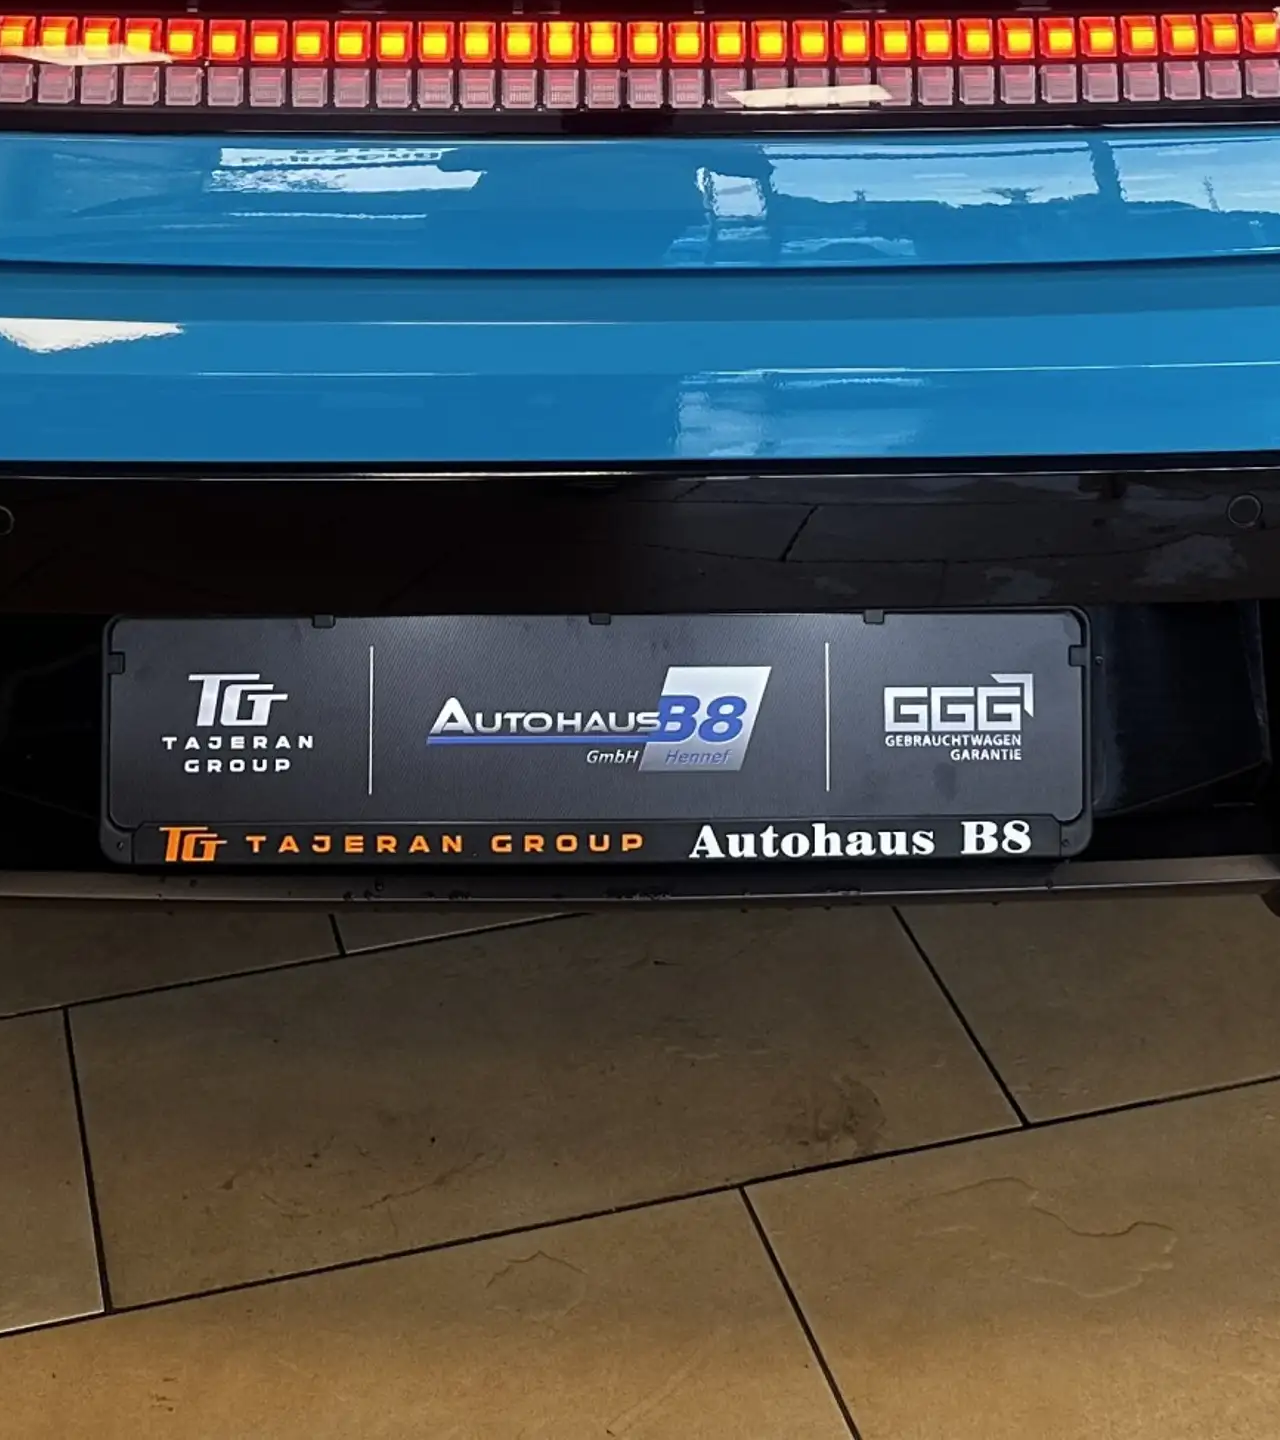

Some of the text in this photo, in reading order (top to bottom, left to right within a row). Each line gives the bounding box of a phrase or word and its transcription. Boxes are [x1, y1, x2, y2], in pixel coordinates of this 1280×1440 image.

[187, 673, 289, 727] TG
[883, 685, 1022, 733] GGG
[161, 735, 315, 751] TAJERAN
[884, 733, 1022, 748] GEBRAUCHTWAGEN
[585, 748, 733, 766] GmbH Hennef
[949, 748, 1022, 761] GARANTIE
[183, 758, 292, 774] GROUP
[158, 819, 1033, 863] TG TAJERAN GROUP Autohaus B8
